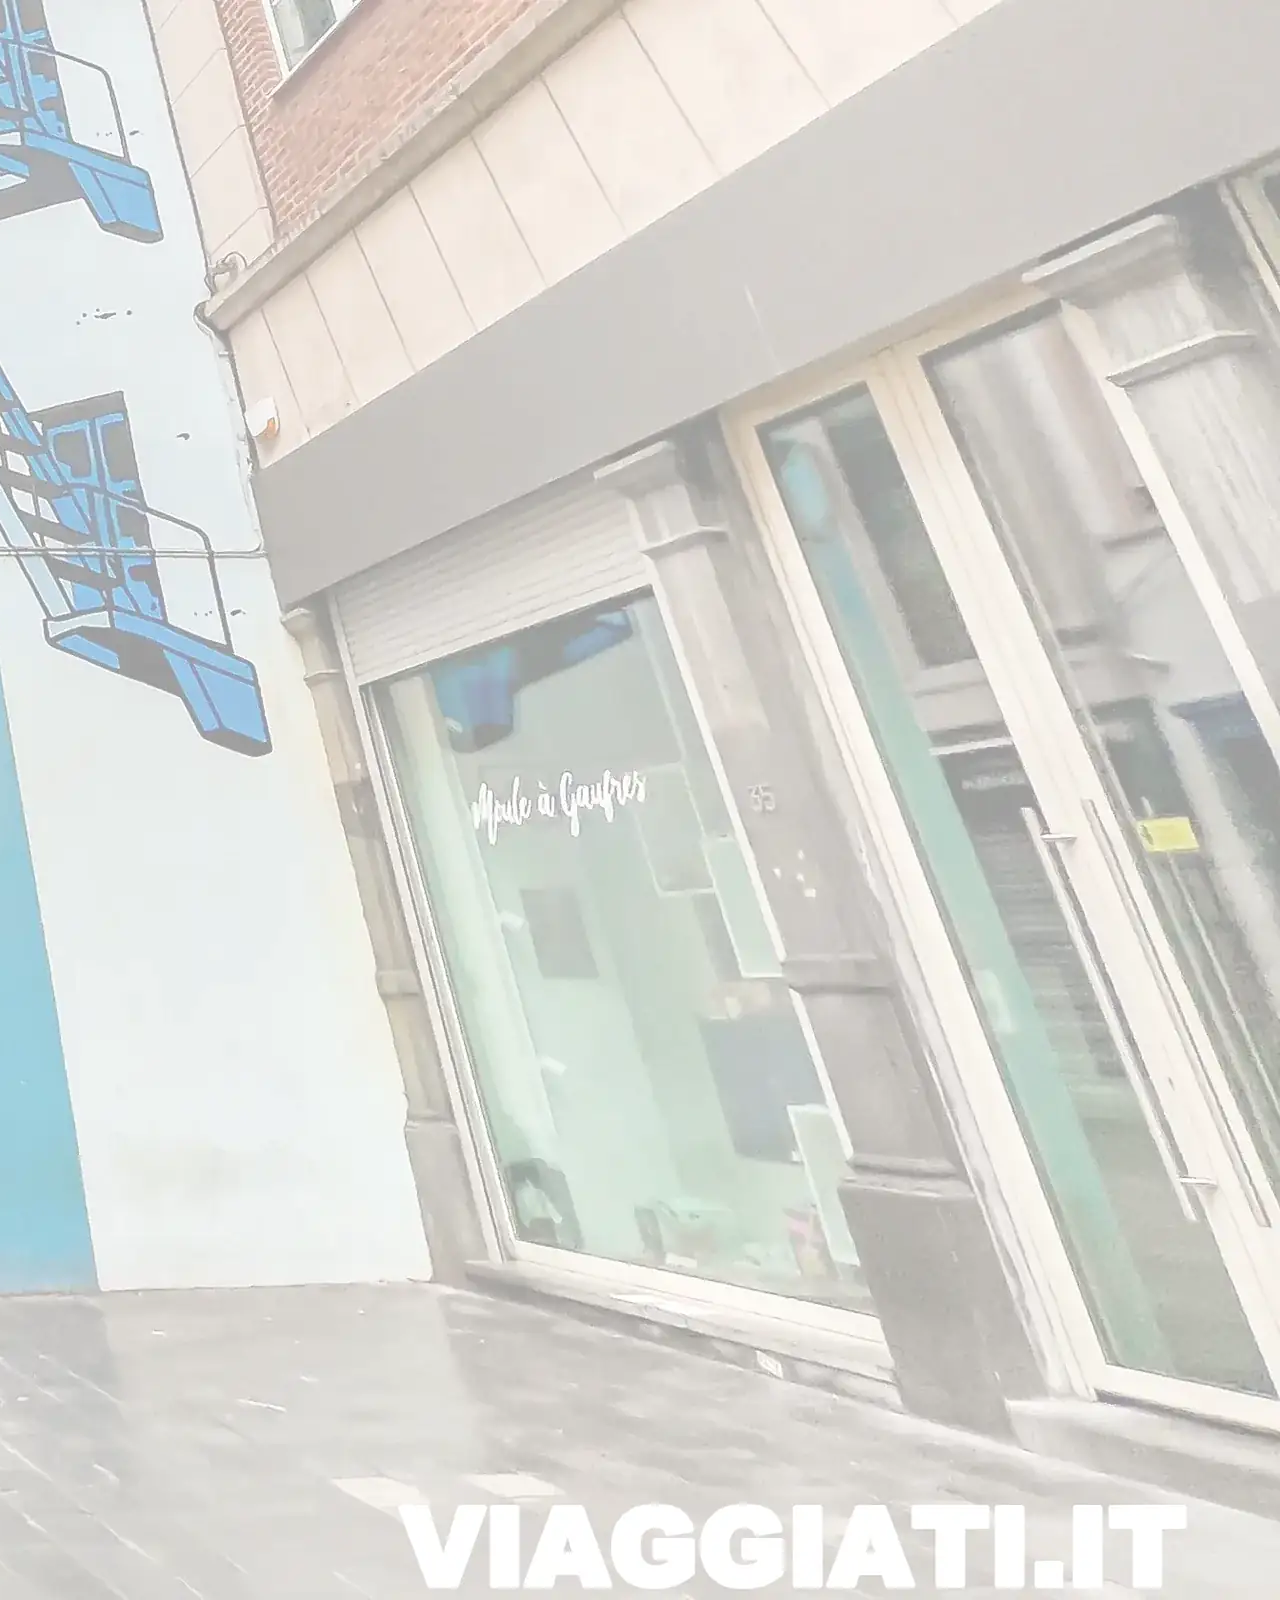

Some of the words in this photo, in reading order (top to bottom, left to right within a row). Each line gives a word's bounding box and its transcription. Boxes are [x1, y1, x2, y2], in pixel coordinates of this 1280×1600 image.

[471, 774, 532, 847] Moule
[536, 779, 557, 818] à
[559, 768, 648, 838] Gaufres
